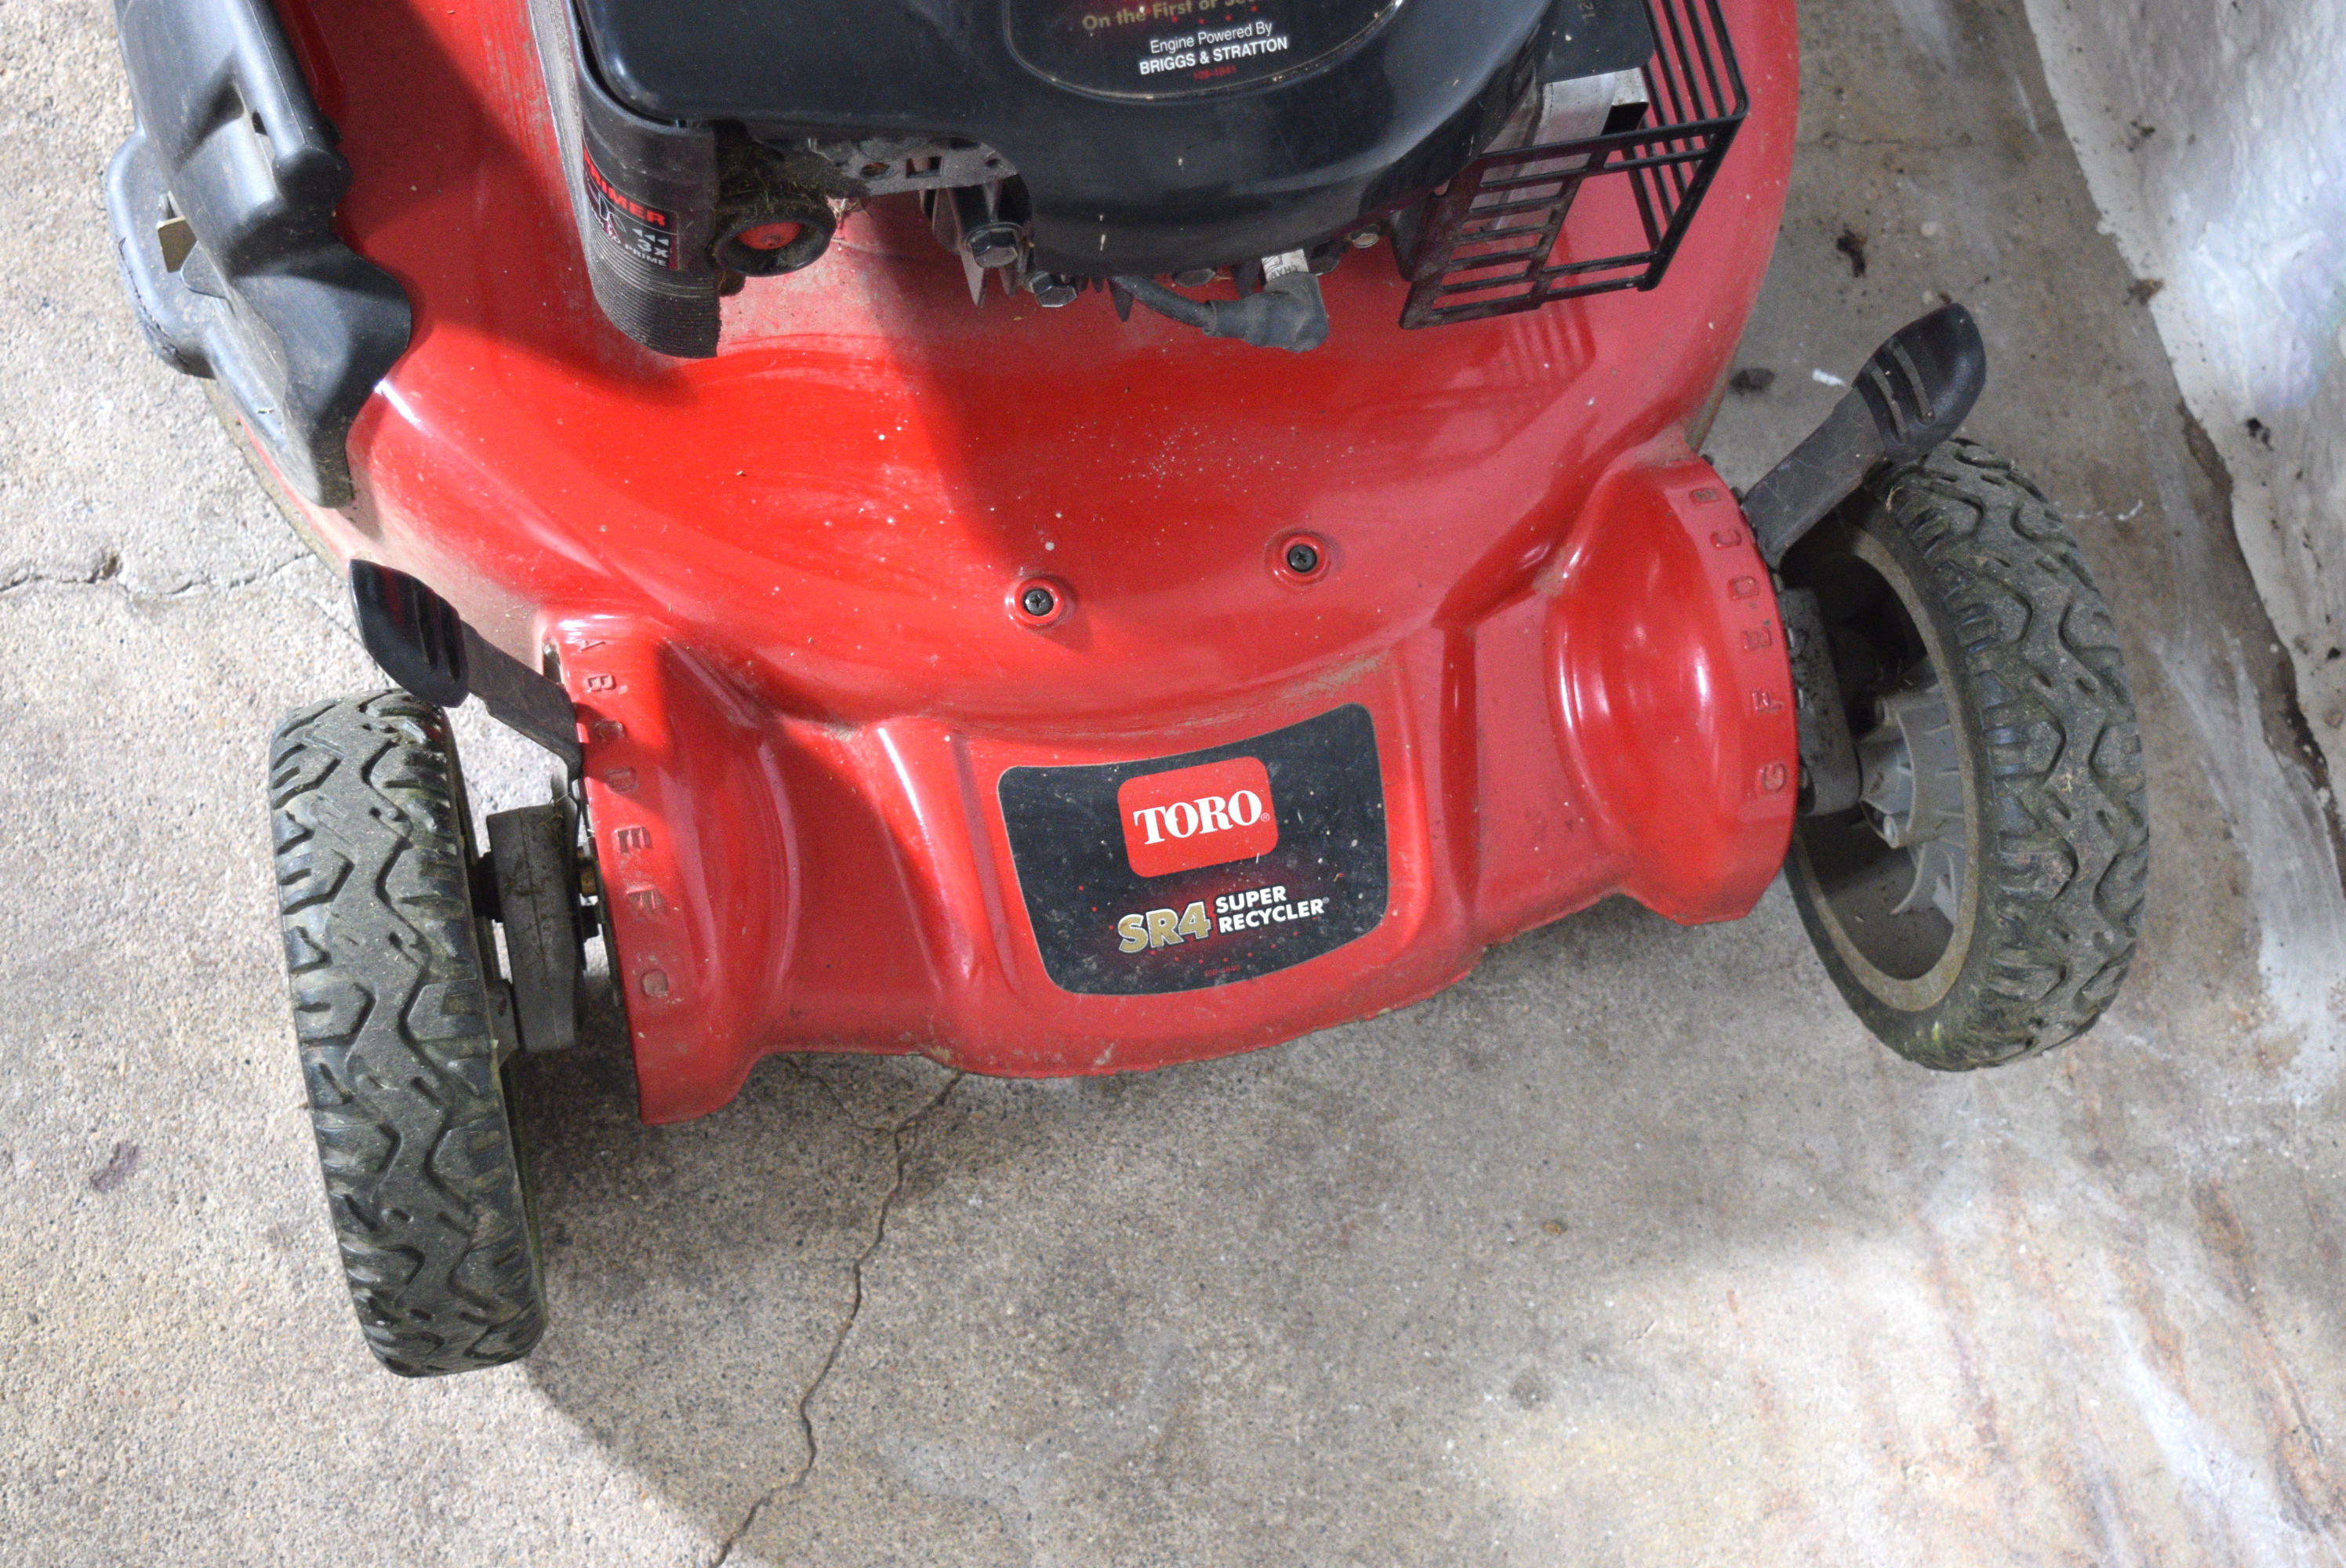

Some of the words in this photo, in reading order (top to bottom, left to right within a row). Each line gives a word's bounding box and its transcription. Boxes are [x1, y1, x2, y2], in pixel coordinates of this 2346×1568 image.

[1082, 14, 1110, 30] On
[1116, 8, 1146, 25] the
[1151, 0, 1193, 19] First
[1149, 34, 1194, 54] Engine
[1197, 24, 1253, 45] Powered
[1255, 21, 1273, 36] By
[1138, 53, 1197, 76] BRIGGS
[1199, 50, 1210, 64] &
[1212, 37, 1288, 62] STRATTON
[625, 244, 667, 267] PRIME
[1741, 630, 1774, 651] E
[588, 674, 617, 693] B
[1133, 789, 1262, 845] TORO
[1118, 902, 1211, 953] SR4
[1215, 885, 1287, 913] SUPER
[1218, 898, 1324, 933] RECYCLER
